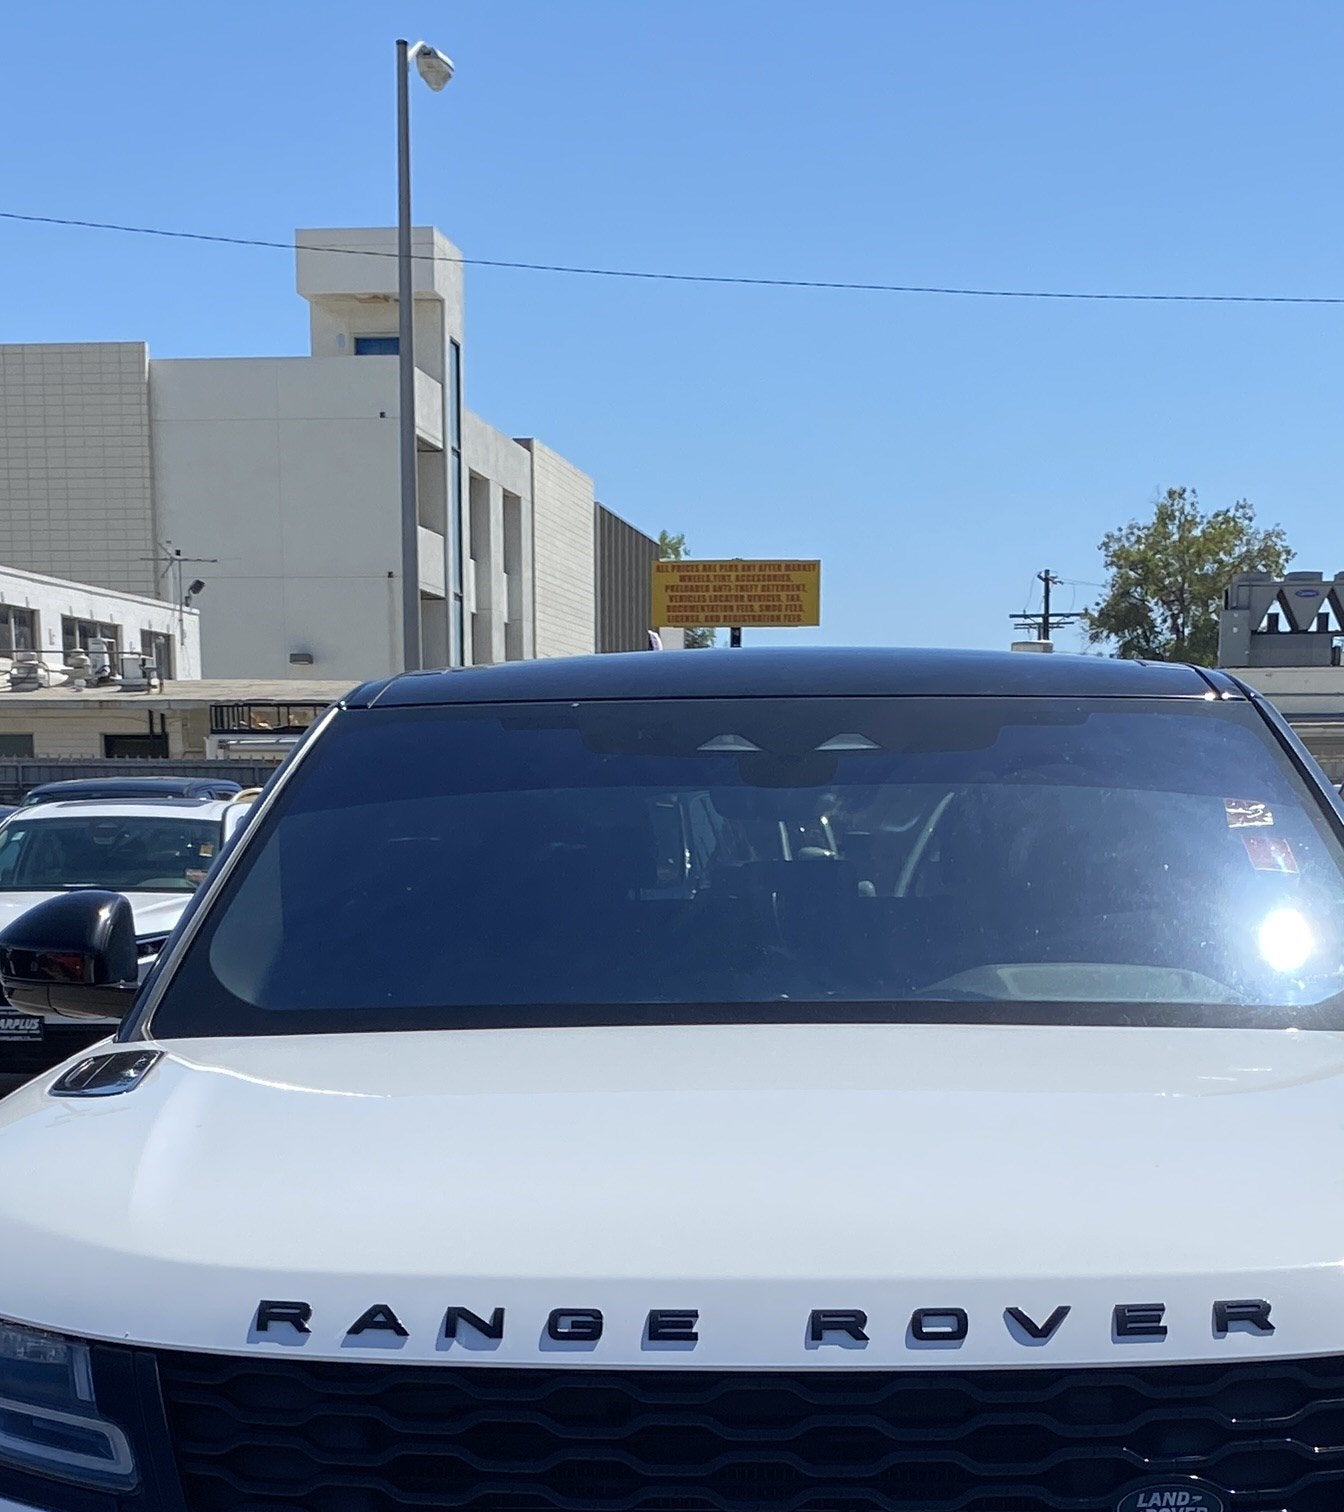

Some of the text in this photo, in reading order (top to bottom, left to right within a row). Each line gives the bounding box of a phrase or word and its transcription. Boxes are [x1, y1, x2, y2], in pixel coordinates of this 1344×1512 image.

[656, 564, 669, 573] ALL
[671, 564, 699, 573] PRICES
[702, 564, 717, 573] ARE
[719, 564, 739, 573] PLUS
[758, 564, 782, 572] AFTER
[784, 564, 816, 572] MARKET
[704, 614, 721, 623] AND
[256, 1299, 1276, 1341] RANGE ROVER
[1136, 1491, 1189, 1508] LAND
